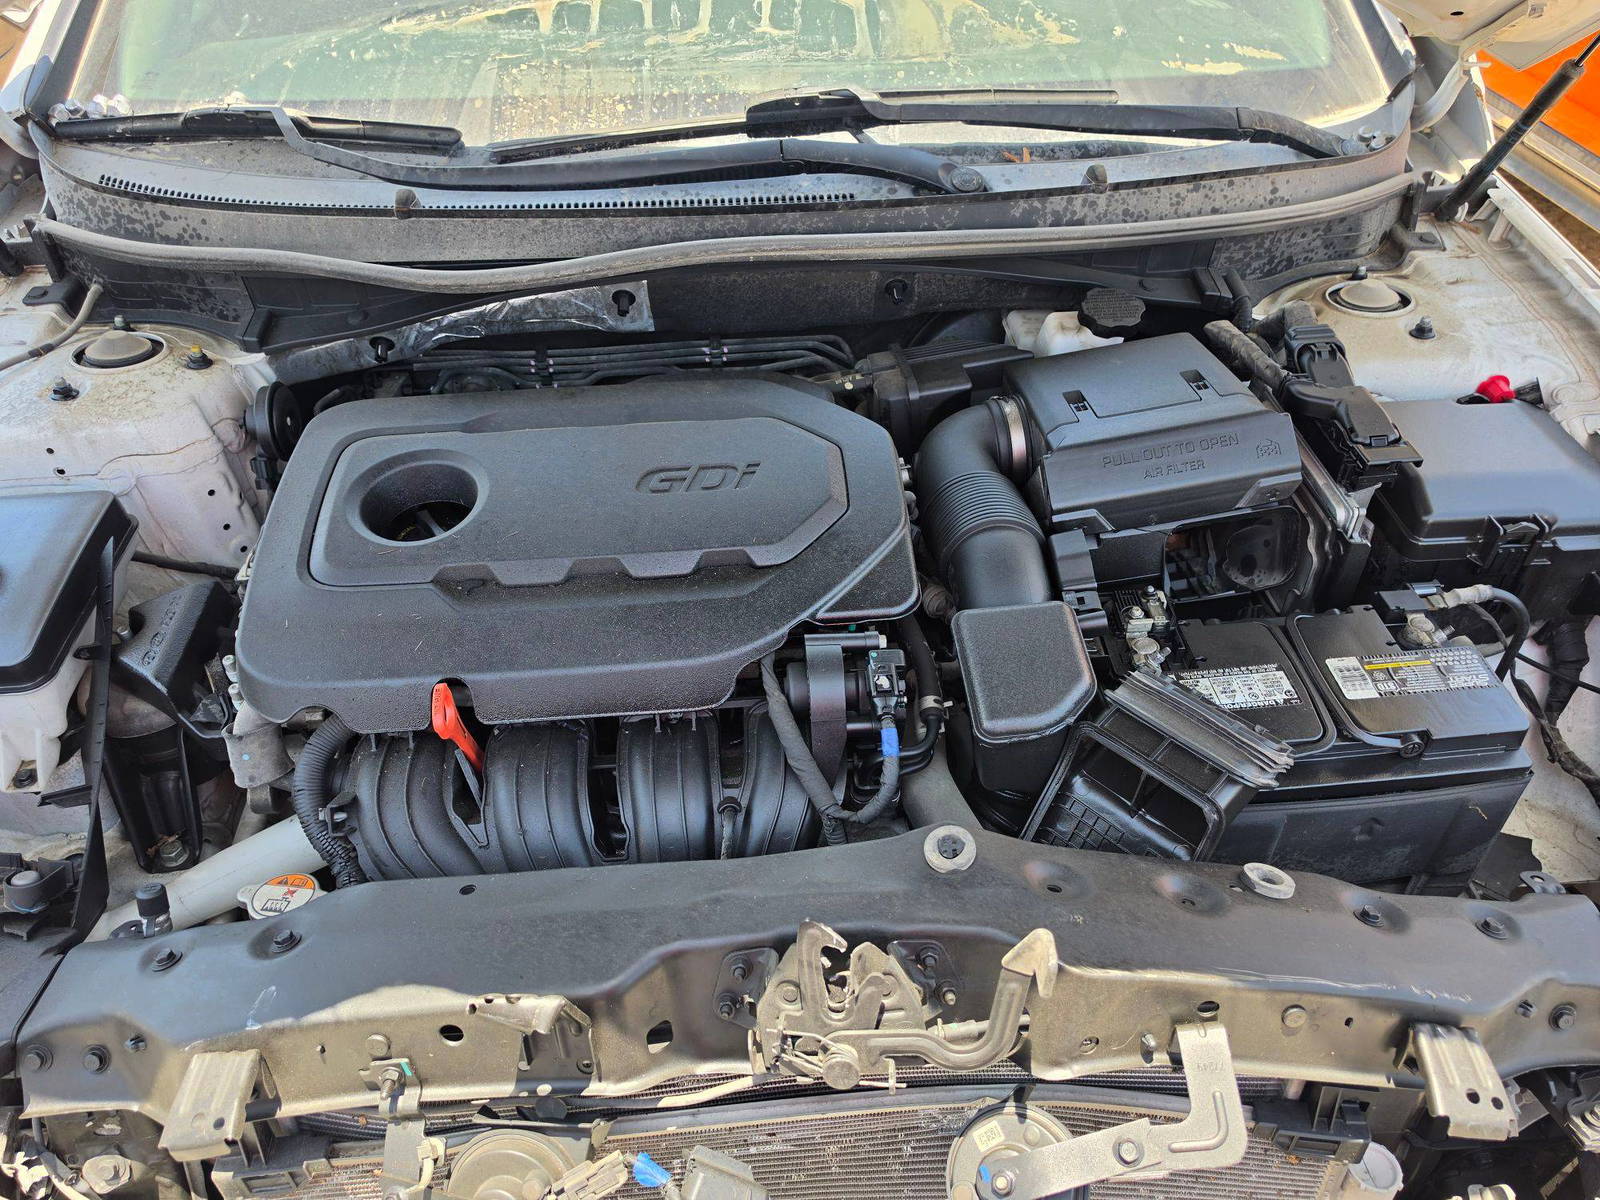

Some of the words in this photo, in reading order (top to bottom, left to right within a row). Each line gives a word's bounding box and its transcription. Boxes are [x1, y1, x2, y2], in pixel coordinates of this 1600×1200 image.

[1102, 454, 1140, 469] PULL
[1142, 445, 1172, 461] OUT
[1174, 440, 1196, 456] TO
[1199, 432, 1240, 451] OPEN
[1143, 466, 1164, 480] AIR
[1166, 459, 1207, 476] FILTER
